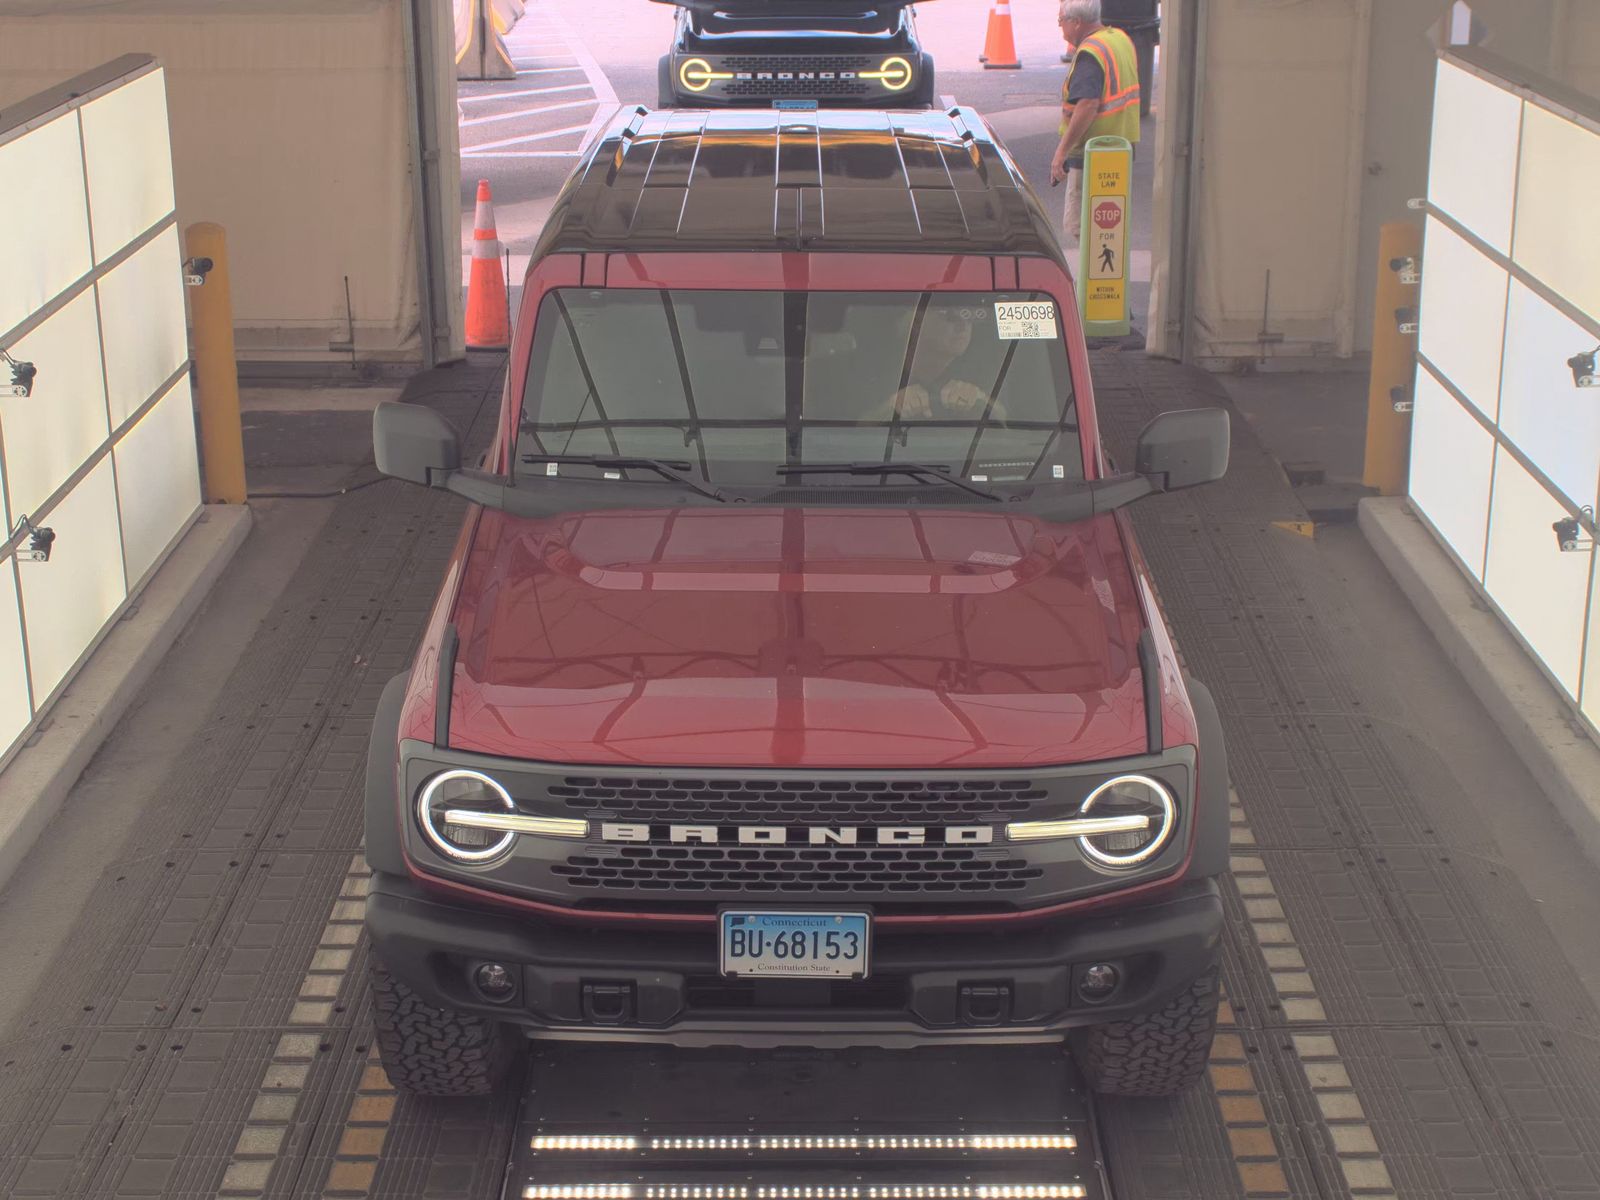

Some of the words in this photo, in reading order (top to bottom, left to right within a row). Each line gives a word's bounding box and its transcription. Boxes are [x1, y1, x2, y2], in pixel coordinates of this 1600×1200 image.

[736, 72, 856, 80] BRONCO
[1098, 172, 1120, 180] STATE
[1095, 209, 1120, 221] STOP
[998, 305, 1055, 320] 2450698
[601, 823, 994, 844] BRONCO
[762, 917, 827, 927] Connecticut
[757, 962, 808, 972] Constitution
[810, 963, 831, 972] State
